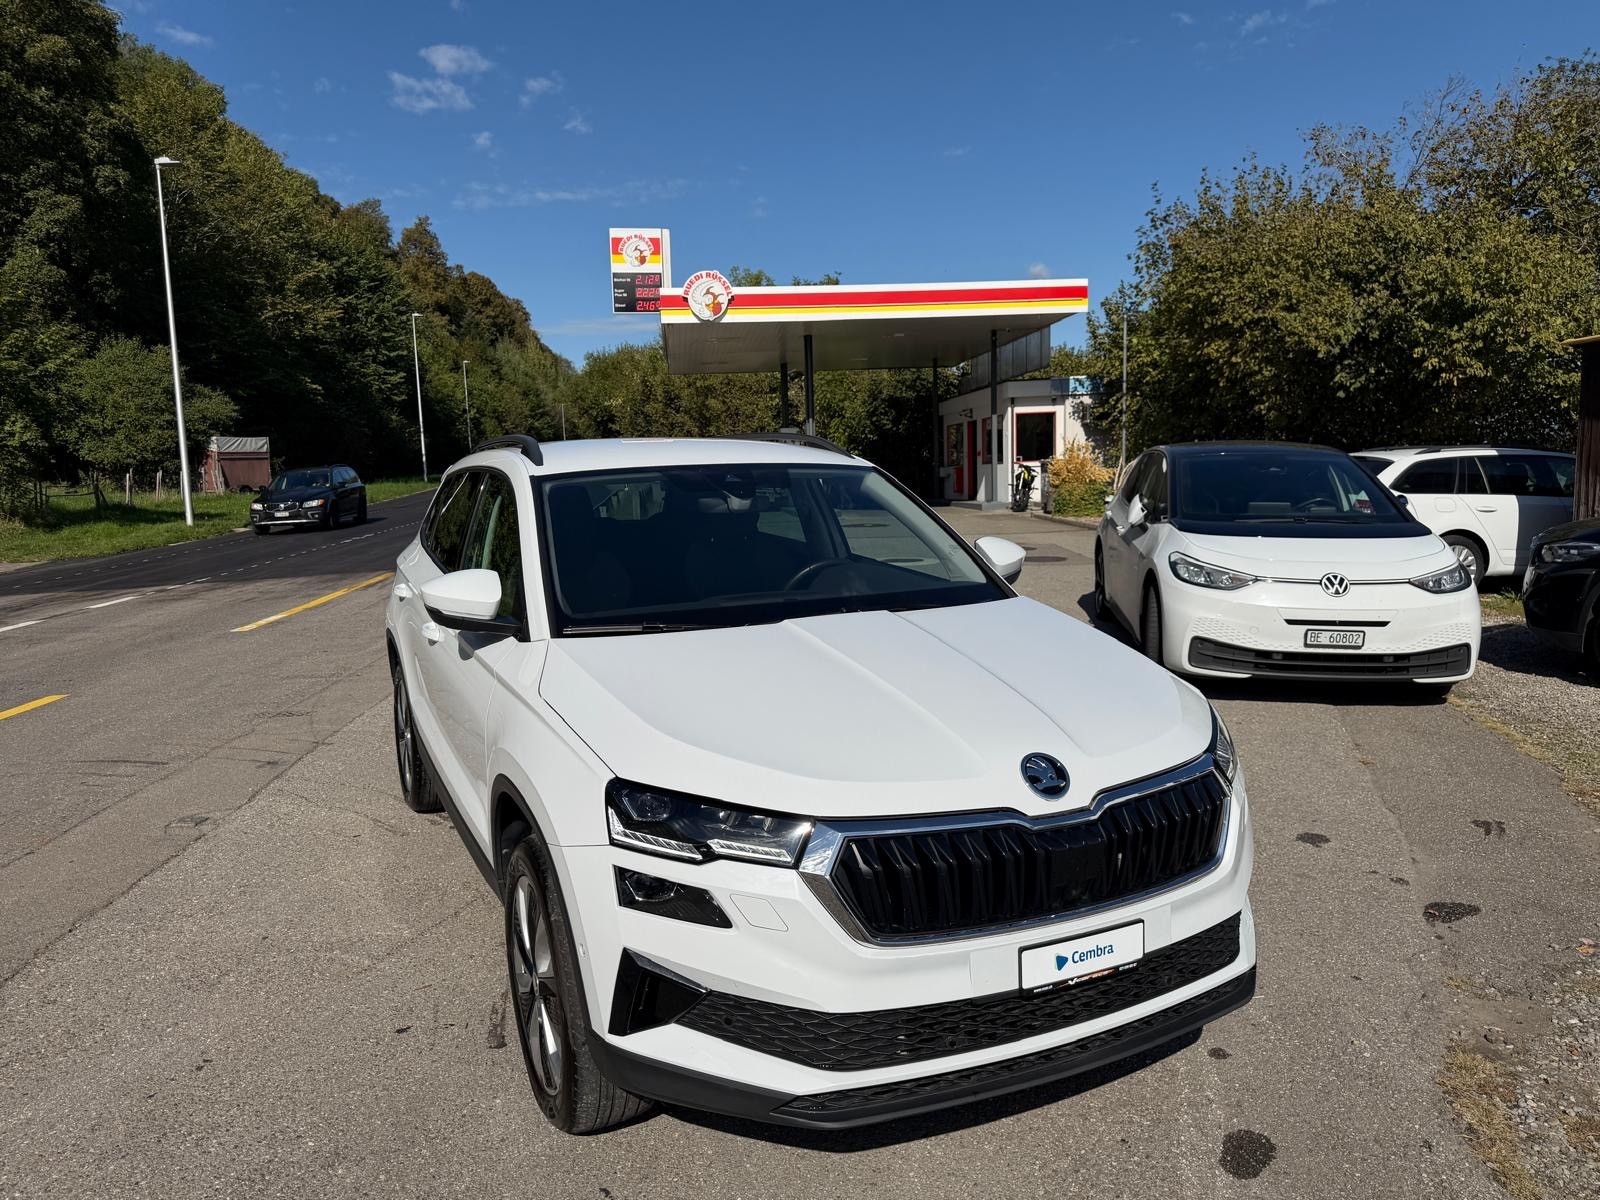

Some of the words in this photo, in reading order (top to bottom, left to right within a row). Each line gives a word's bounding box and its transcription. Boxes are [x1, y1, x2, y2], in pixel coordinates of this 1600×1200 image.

[684, 273, 703, 296] RUEDI
[705, 271, 732, 297] RÜSSEL
[1309, 631, 1323, 643] BE
[1329, 633, 1361, 645] 60802
[1071, 944, 1114, 964] Cembra
